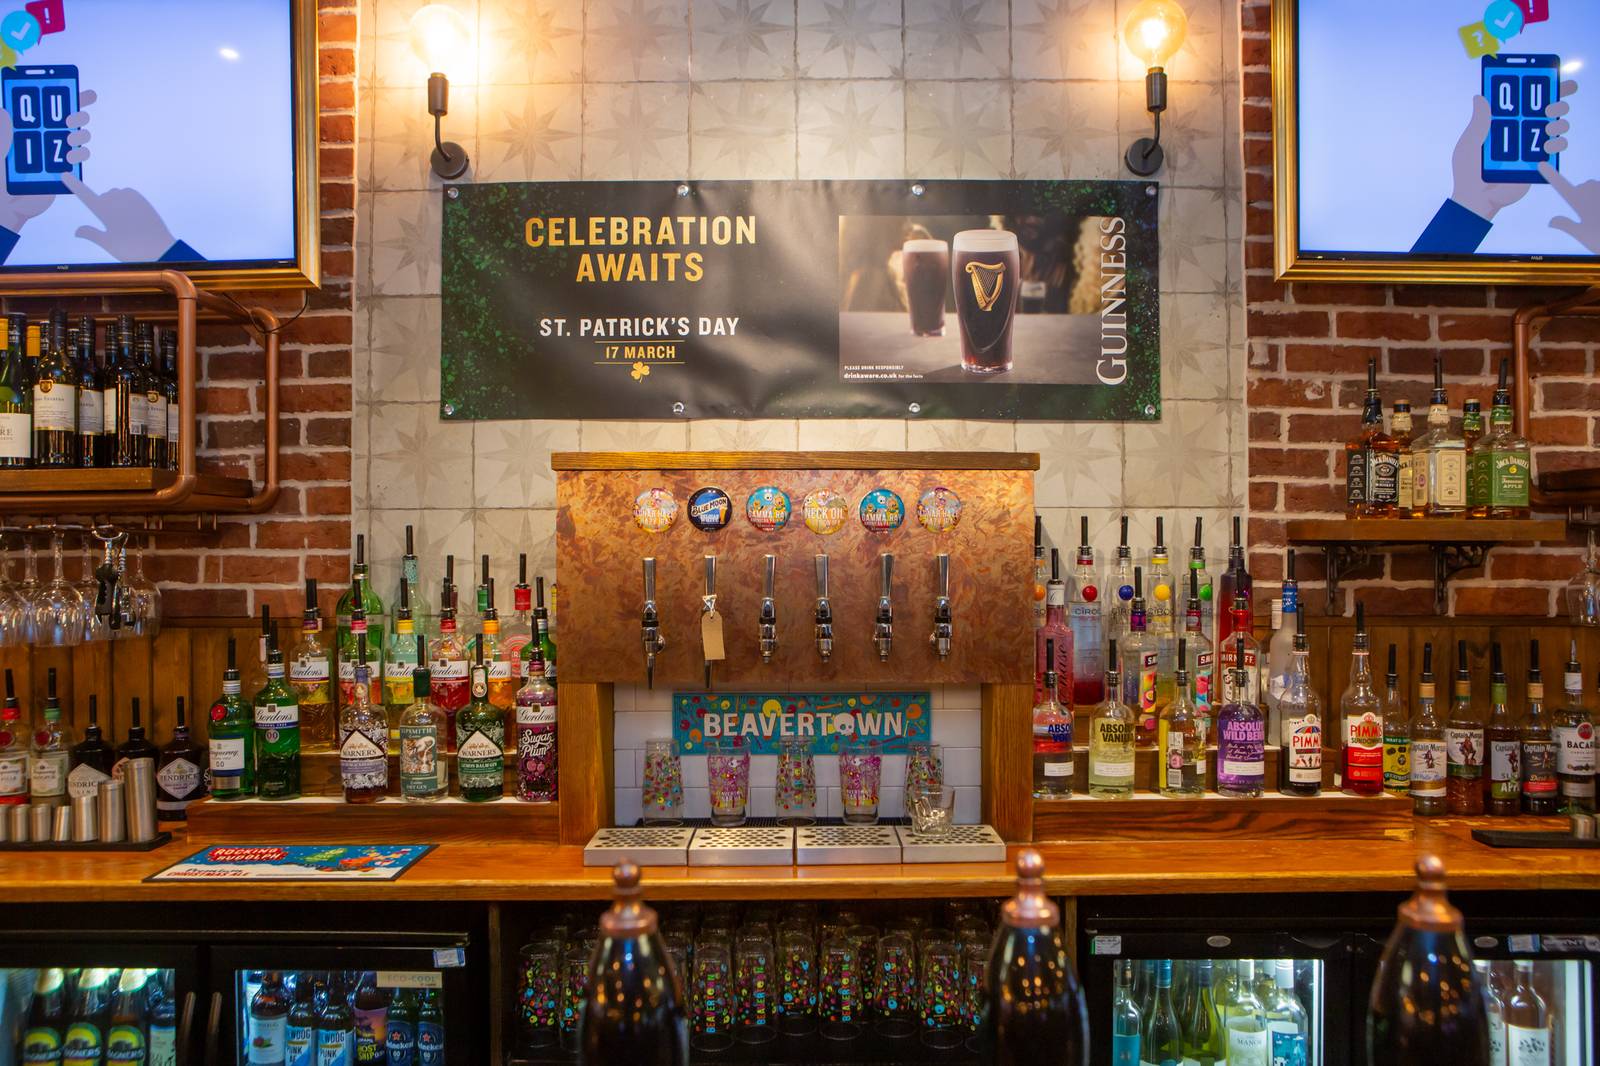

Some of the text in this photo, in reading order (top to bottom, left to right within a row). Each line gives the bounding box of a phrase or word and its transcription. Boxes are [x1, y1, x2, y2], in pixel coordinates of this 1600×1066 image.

[525, 215, 756, 247] CELEBRATION
[575, 252, 704, 283] AWAITS
[1096, 216, 1128, 386] GUINNESS
[539, 317, 740, 337] ST. PATRICK'S DAY
[606, 345, 676, 359] 17 MARCH
[1496, 458, 1509, 469] JACK
[691, 498, 727, 517] BLUE MOON
[749, 510, 773, 518] GAMMA
[804, 508, 844, 519] NECK OIL
[861, 512, 886, 521] GAMMA
[521, 729, 555, 748] Sugar
[1223, 730, 1246, 741] WILD
[520, 744, 547, 758] Plum
[214, 848, 279, 856] ROCKING
[216, 854, 282, 862] RUDOLPH
